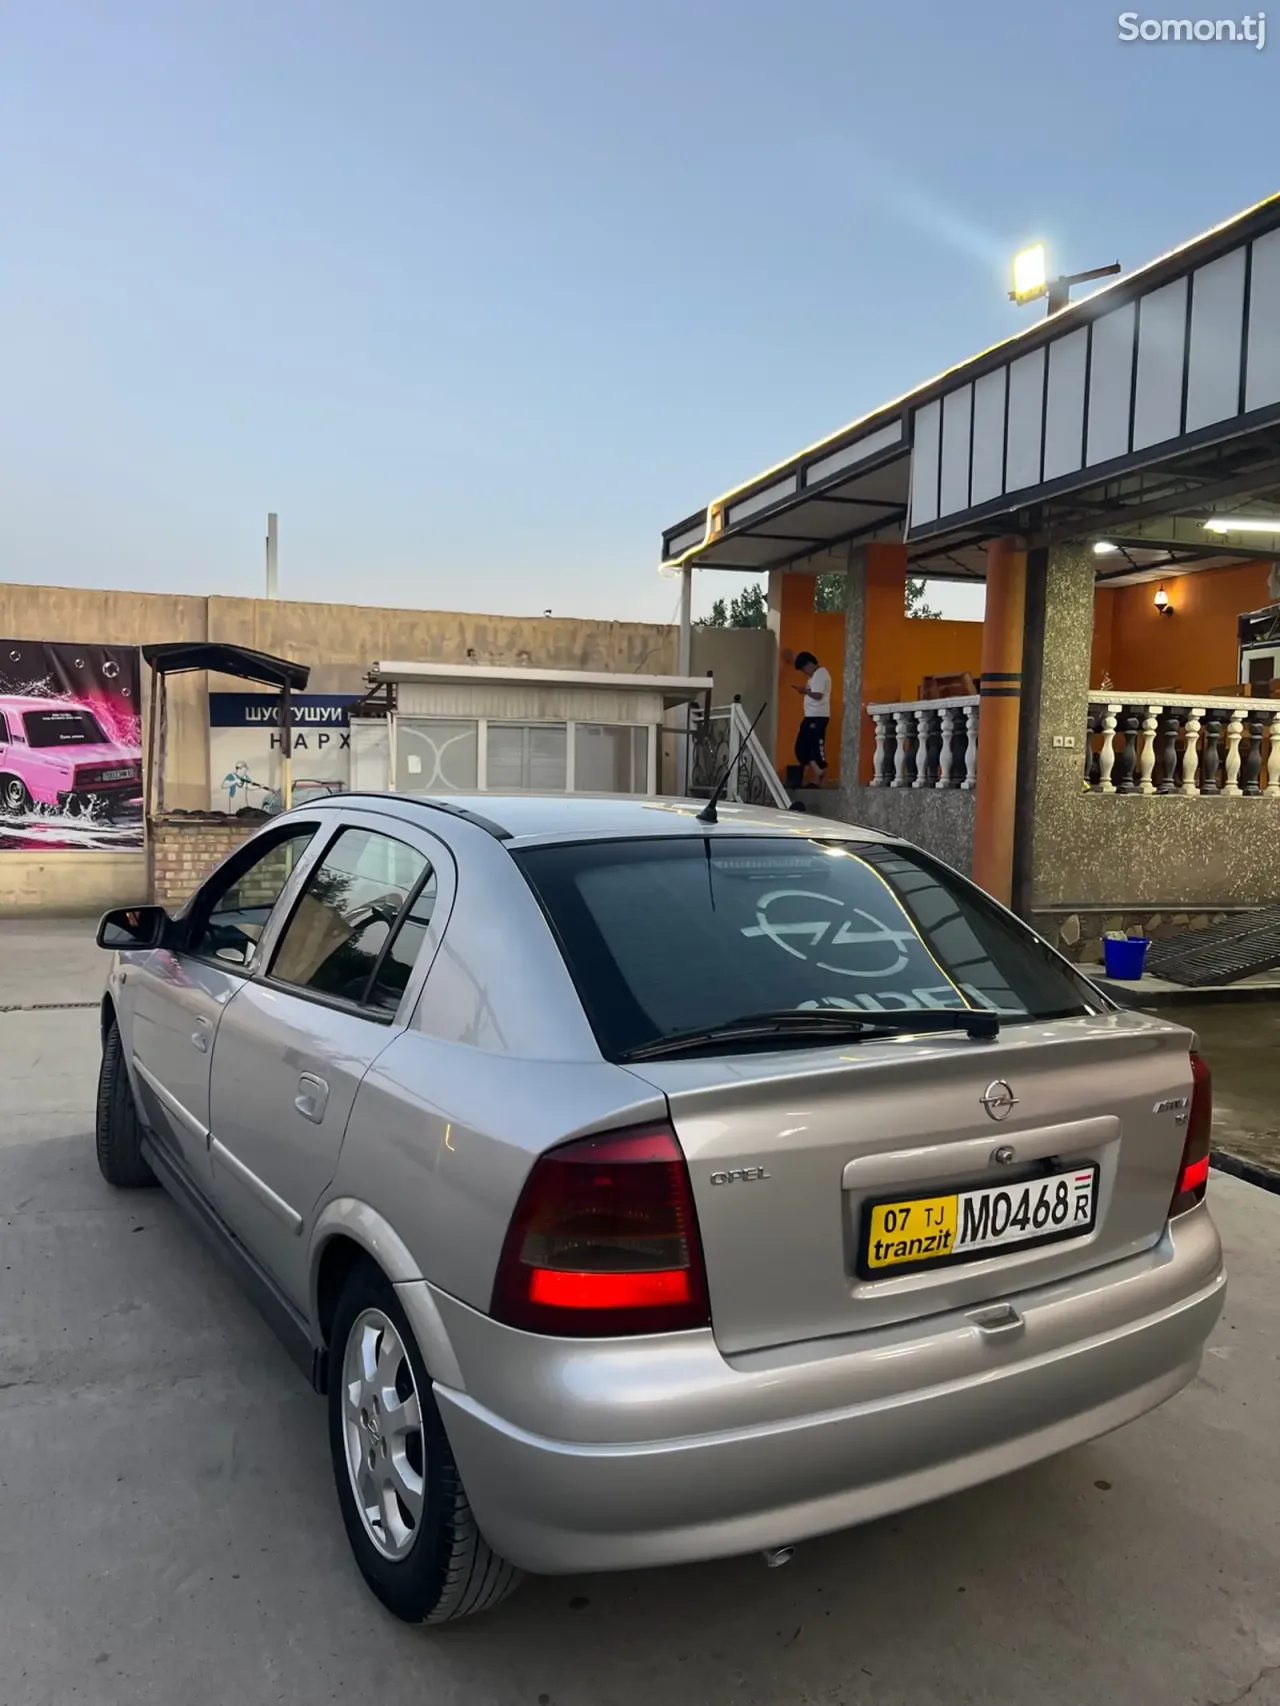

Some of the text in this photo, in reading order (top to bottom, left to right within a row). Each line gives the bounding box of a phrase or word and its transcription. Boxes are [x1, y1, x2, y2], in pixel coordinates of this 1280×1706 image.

[710, 1166, 772, 1187] OPEL
[883, 1206, 945, 1234] 07 TJ
[1074, 1193, 1089, 1221] R
[874, 1229, 952, 1261] tranzit
